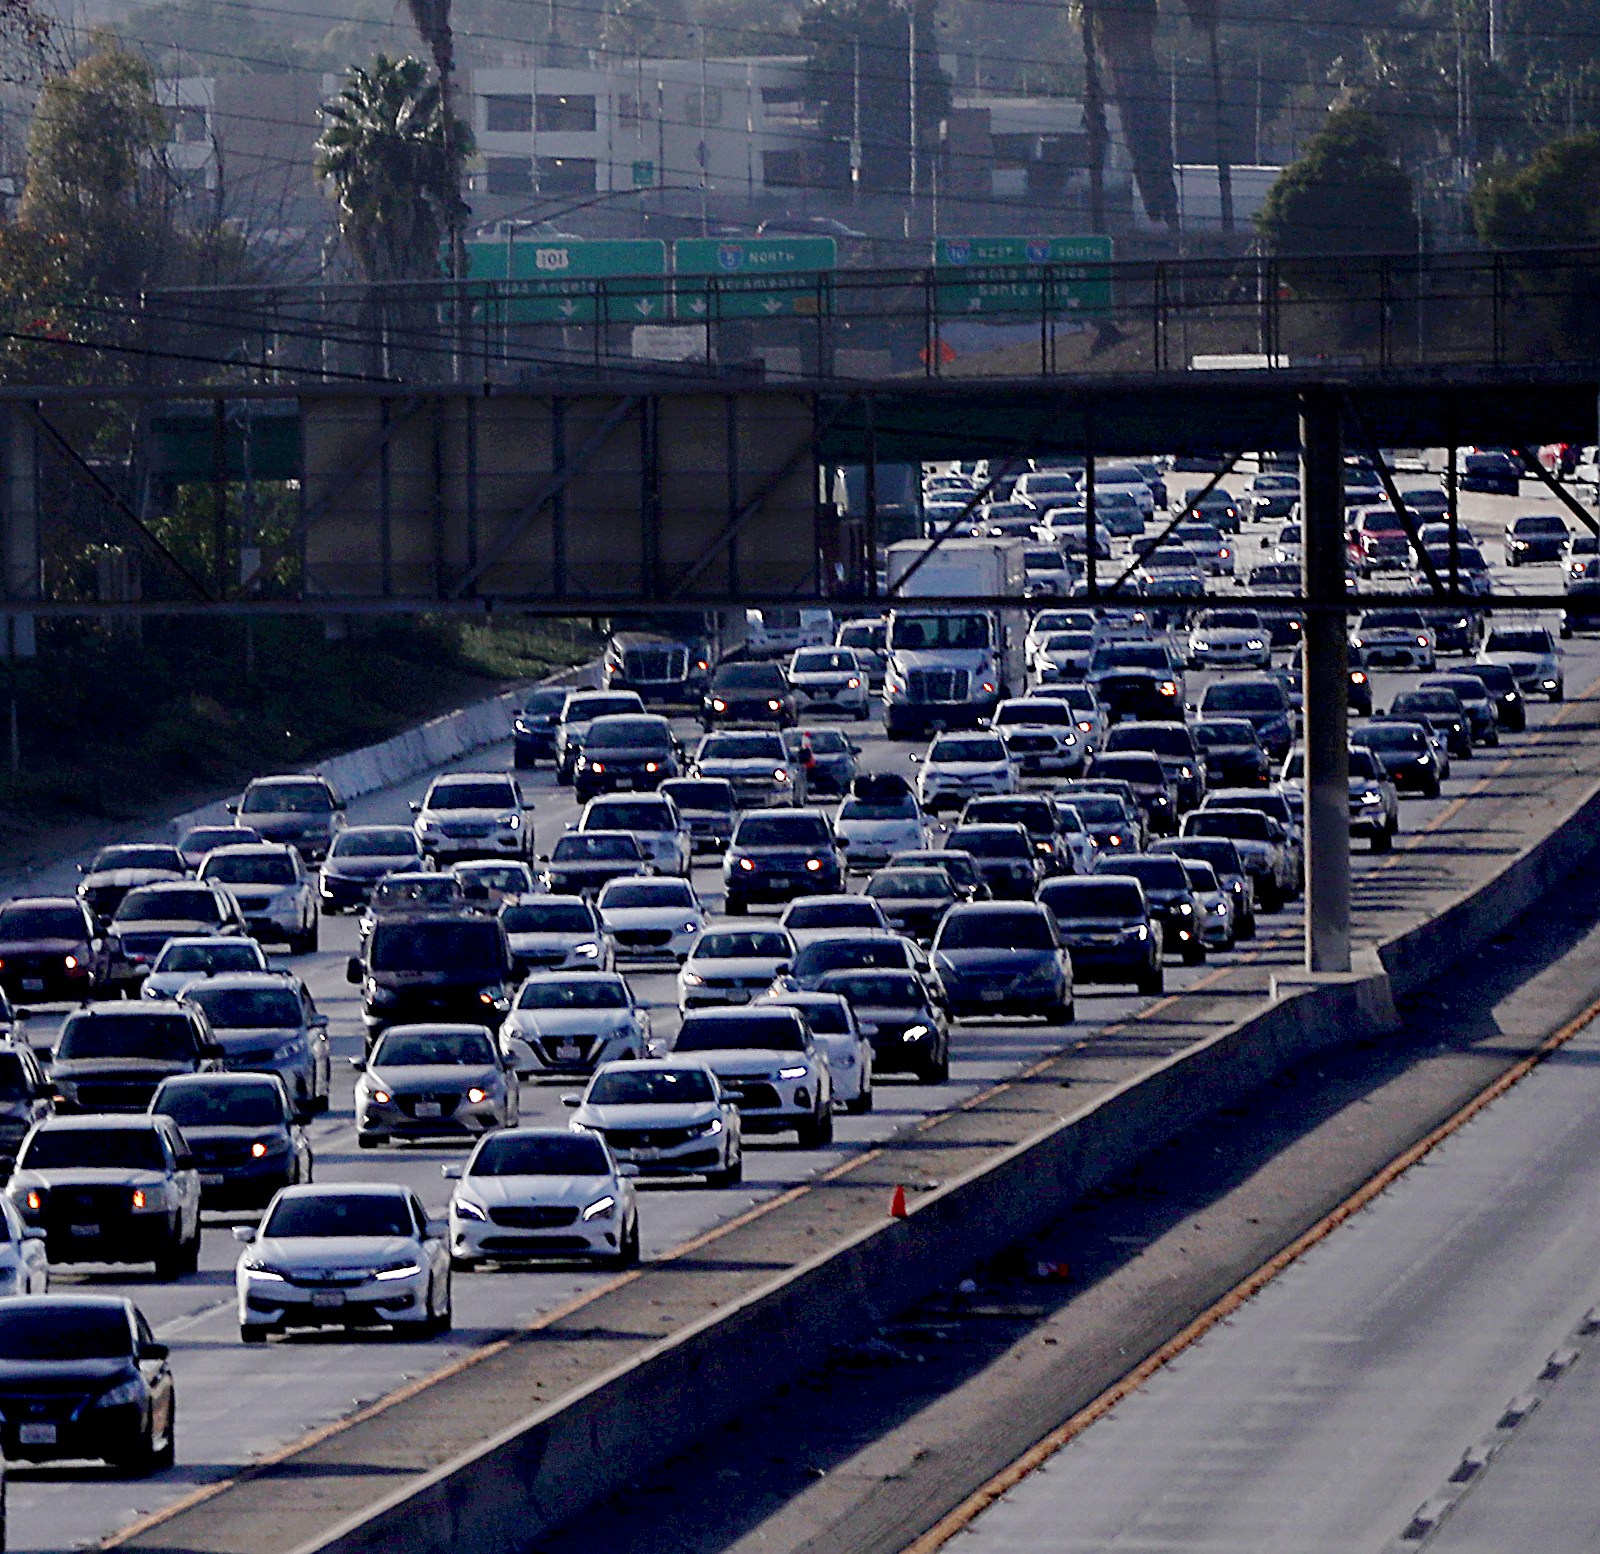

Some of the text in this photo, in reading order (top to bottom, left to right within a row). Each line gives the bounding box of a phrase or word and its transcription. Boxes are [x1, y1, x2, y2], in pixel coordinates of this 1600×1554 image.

[748, 250, 795, 264] NORTH
[1058, 245, 1104, 258] SOUTH
[539, 252, 563, 265] 101
[978, 283, 1029, 297] Santa
